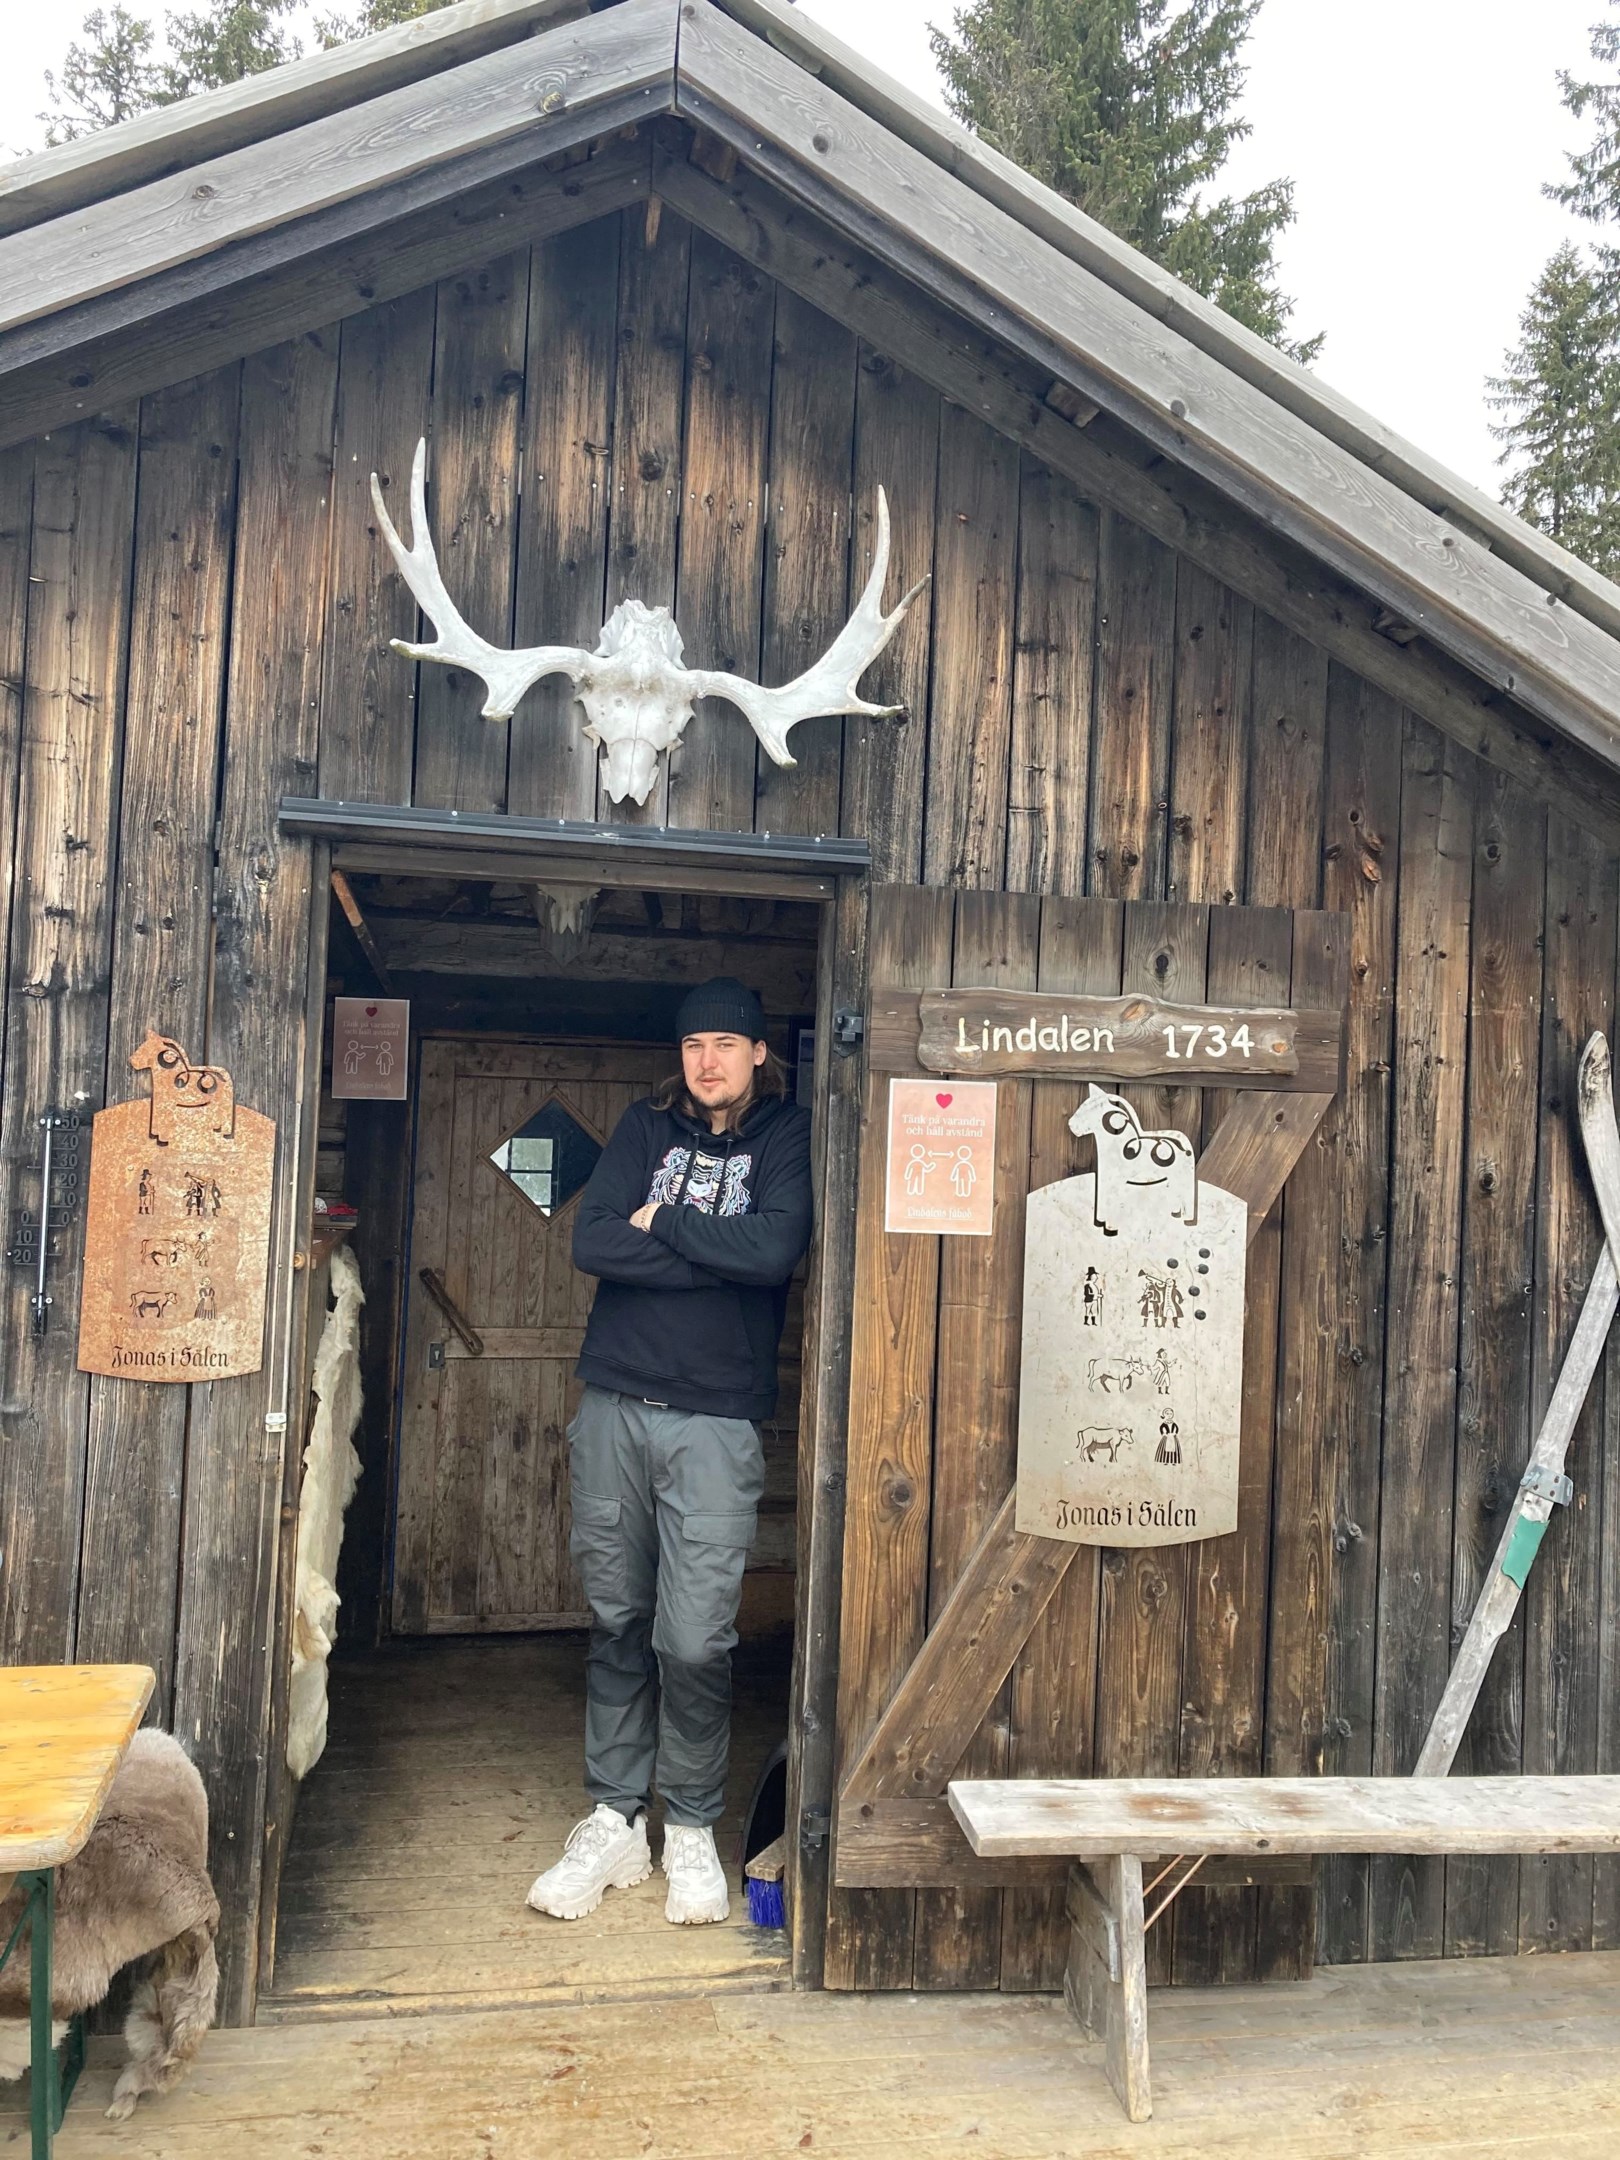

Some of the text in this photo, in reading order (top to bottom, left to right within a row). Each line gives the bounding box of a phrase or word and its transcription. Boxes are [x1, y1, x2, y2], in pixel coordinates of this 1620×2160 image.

[956, 1014, 1255, 1059] Lindalen 1734
[61, 1115, 80, 1130] 50
[902, 1114, 986, 1127] Tänk på varandra
[906, 1125, 983, 1138] och håll avstånd
[61, 1135, 79, 1149] 40
[60, 1154, 78, 1168] 30
[60, 1173, 77, 1187] 20
[16, 1230, 33, 1244] 10
[13, 1249, 32, 1263] 20
[111, 1345, 230, 1369] Jonas i Sälen
[1056, 1498, 1198, 1530] Jonas i Sälen
